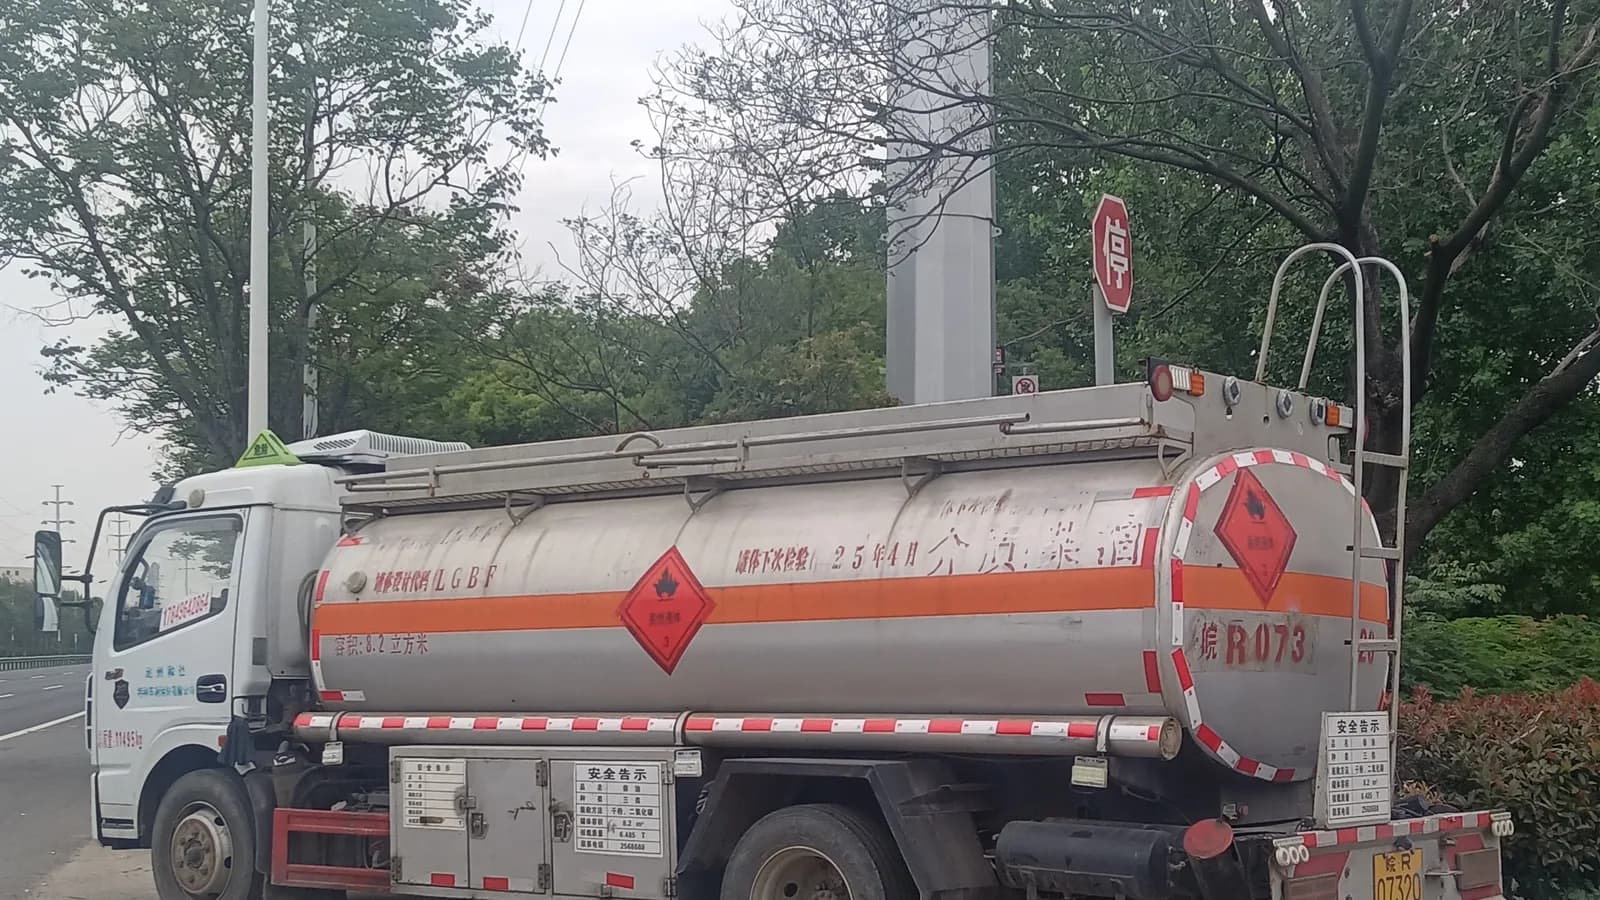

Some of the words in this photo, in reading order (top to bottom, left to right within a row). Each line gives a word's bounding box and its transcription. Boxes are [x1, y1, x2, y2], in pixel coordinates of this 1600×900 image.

[1103, 215, 1129, 290] 停
[1337, 719, 1380, 734] 安全告示
[588, 767, 647, 781] 安全告示
[1377, 872, 1421, 900] 07320
